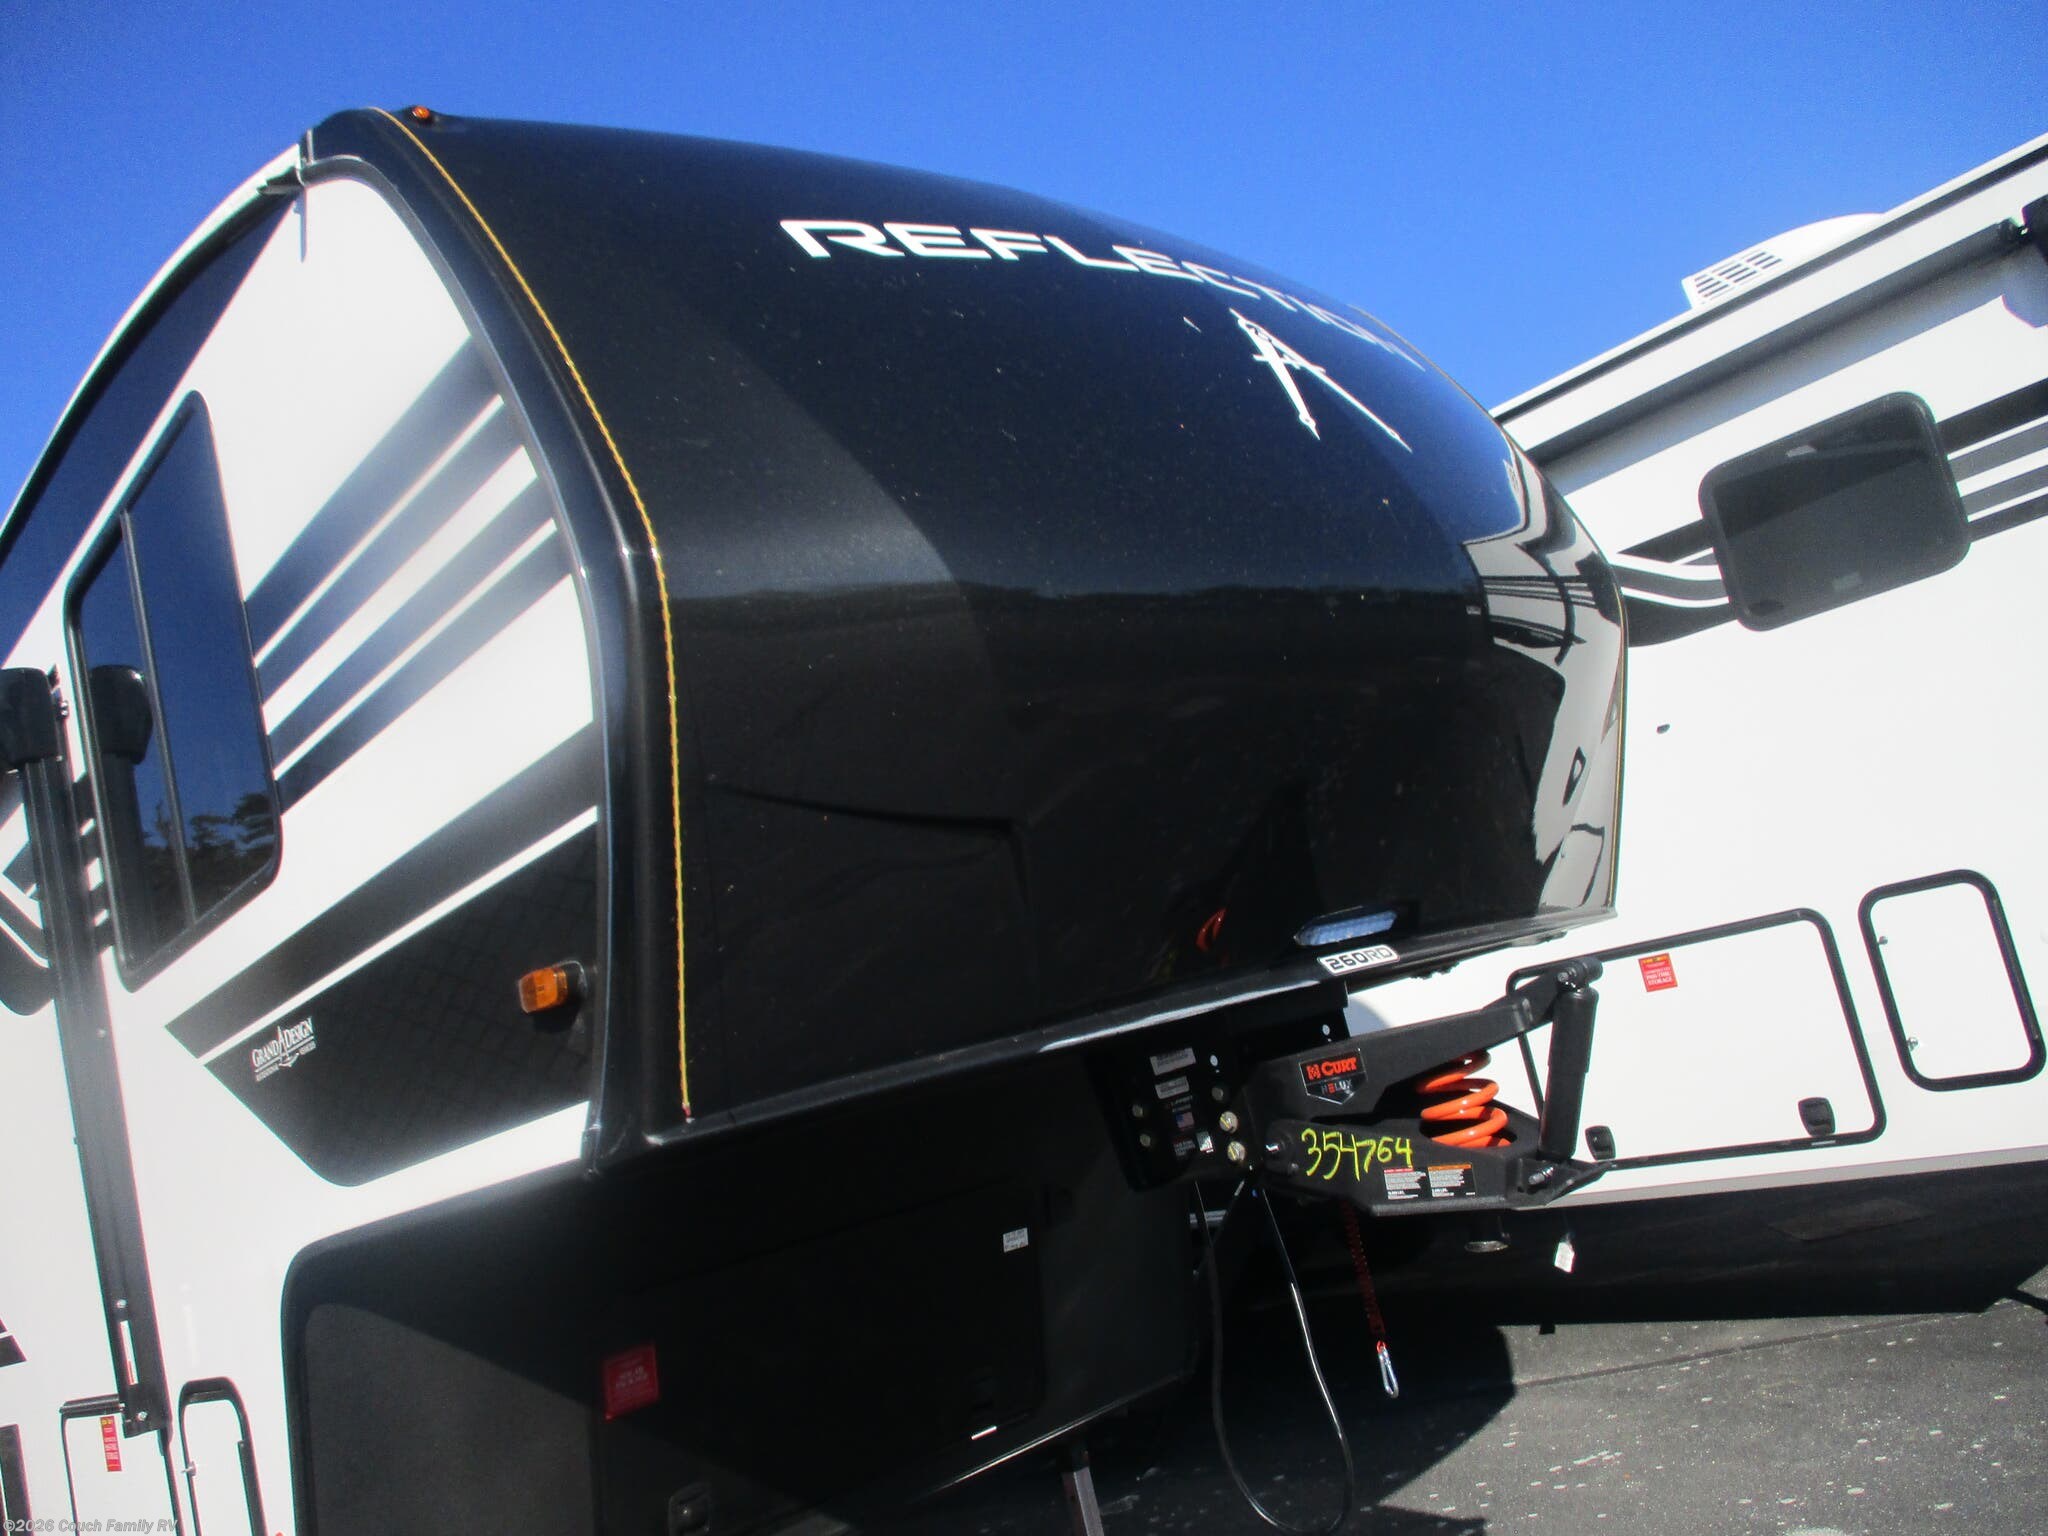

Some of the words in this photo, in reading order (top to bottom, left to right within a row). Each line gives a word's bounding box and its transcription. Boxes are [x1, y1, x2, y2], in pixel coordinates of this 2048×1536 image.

[779, 219, 1426, 373] REFLECTION
[1325, 947, 1393, 970] 260RD
[1321, 1057, 1357, 1076] CURT
[1301, 1128, 1413, 1181] 354764
